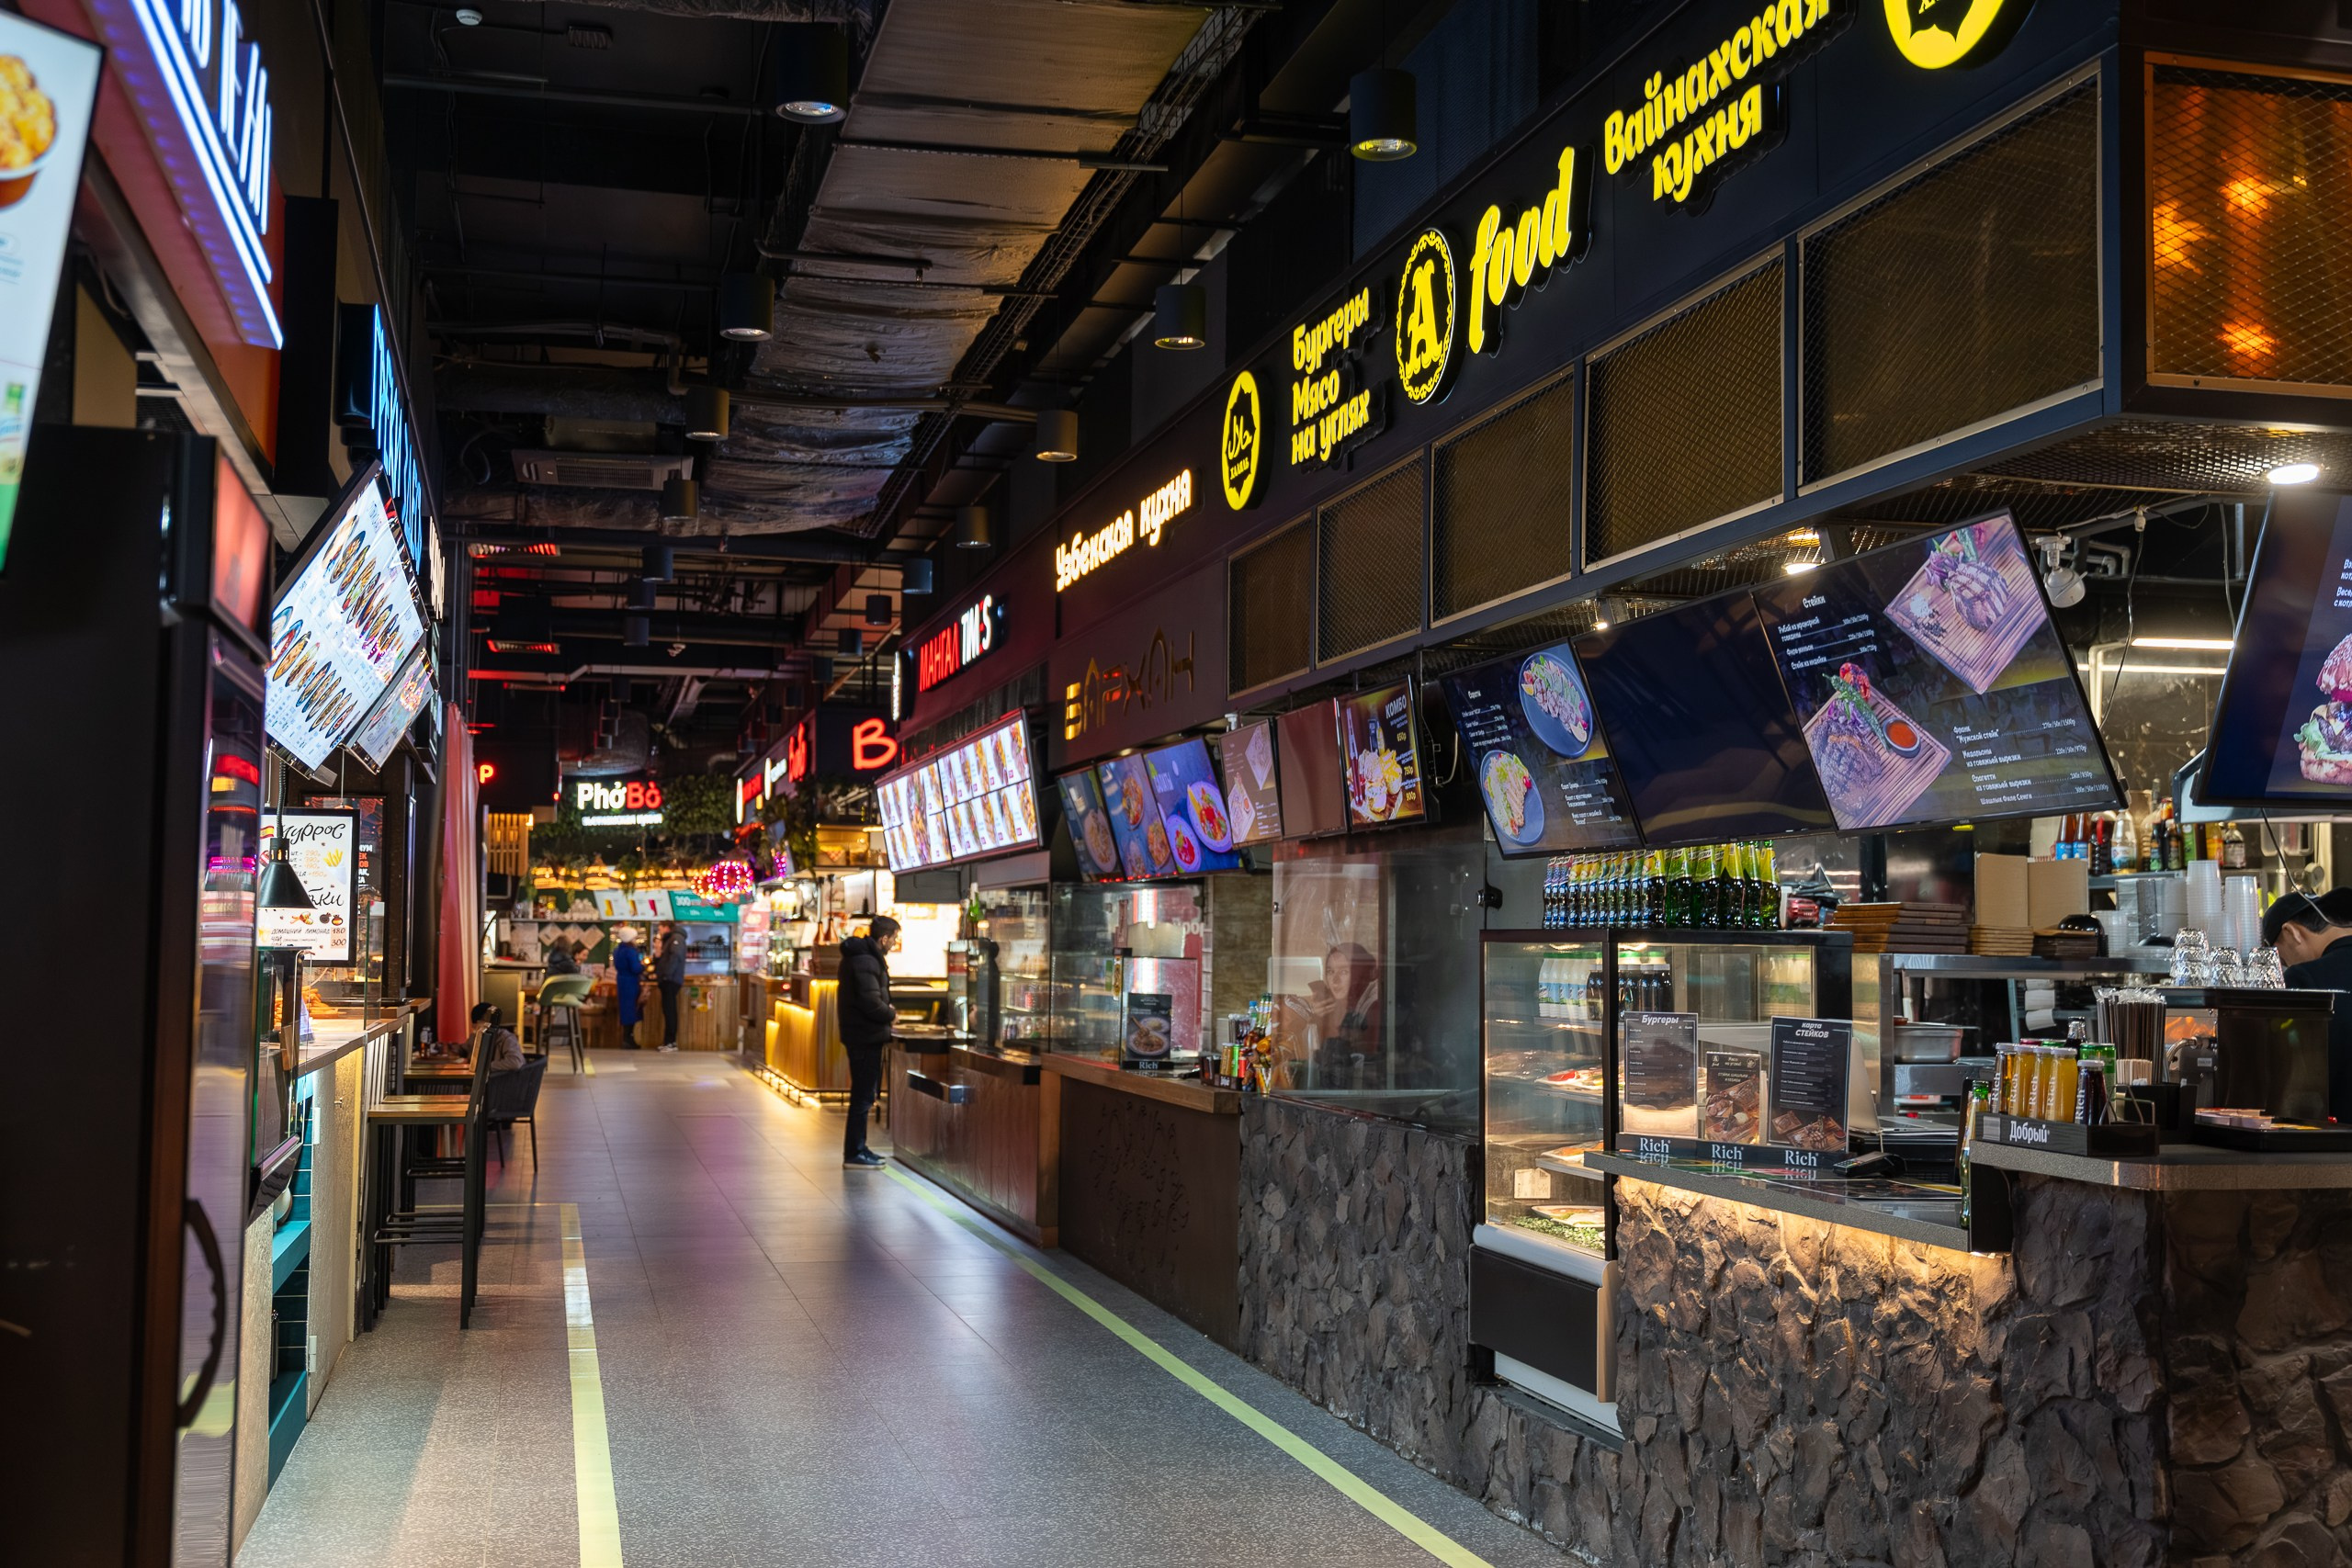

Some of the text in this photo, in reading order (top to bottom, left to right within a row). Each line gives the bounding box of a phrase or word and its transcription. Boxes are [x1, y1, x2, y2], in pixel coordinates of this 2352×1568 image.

[1604, 0, 1829, 175] Вайнахская
[1652, 84, 1762, 203] кухня
[1468, 146, 1575, 355] food
[1293, 287, 1370, 375] Бургеры
[1292, 369, 1340, 426] Мясо
[1291, 389, 1371, 466] на углях
[1056, 468, 1192, 592] Узбекская кухня
[1802, 595, 1826, 608] Стейки
[919, 622, 961, 693] МАНГАЛ
[1064, 625, 1195, 741] БАРХАН
[1385, 694, 1408, 718] КОМБО
[331, 938, 347, 947] 300
[1641, 1014, 1679, 1026] Бургеры
[1795, 1029, 1829, 1039] СТЕЙКОВ
[1139, 1061, 1159, 1070] Rich
[1991, 1071, 2001, 1101] Rich
[2029, 1075, 2039, 1105] Rich
[2047, 1076, 2056, 1106] Rich
[2075, 1089, 2086, 1121] Rich
[1640, 1137, 1669, 1154] Rich
[2009, 1120, 2049, 1144] Добрый
[1712, 1144, 1744, 1160] Rich
[1784, 1150, 1818, 1167] Rich
